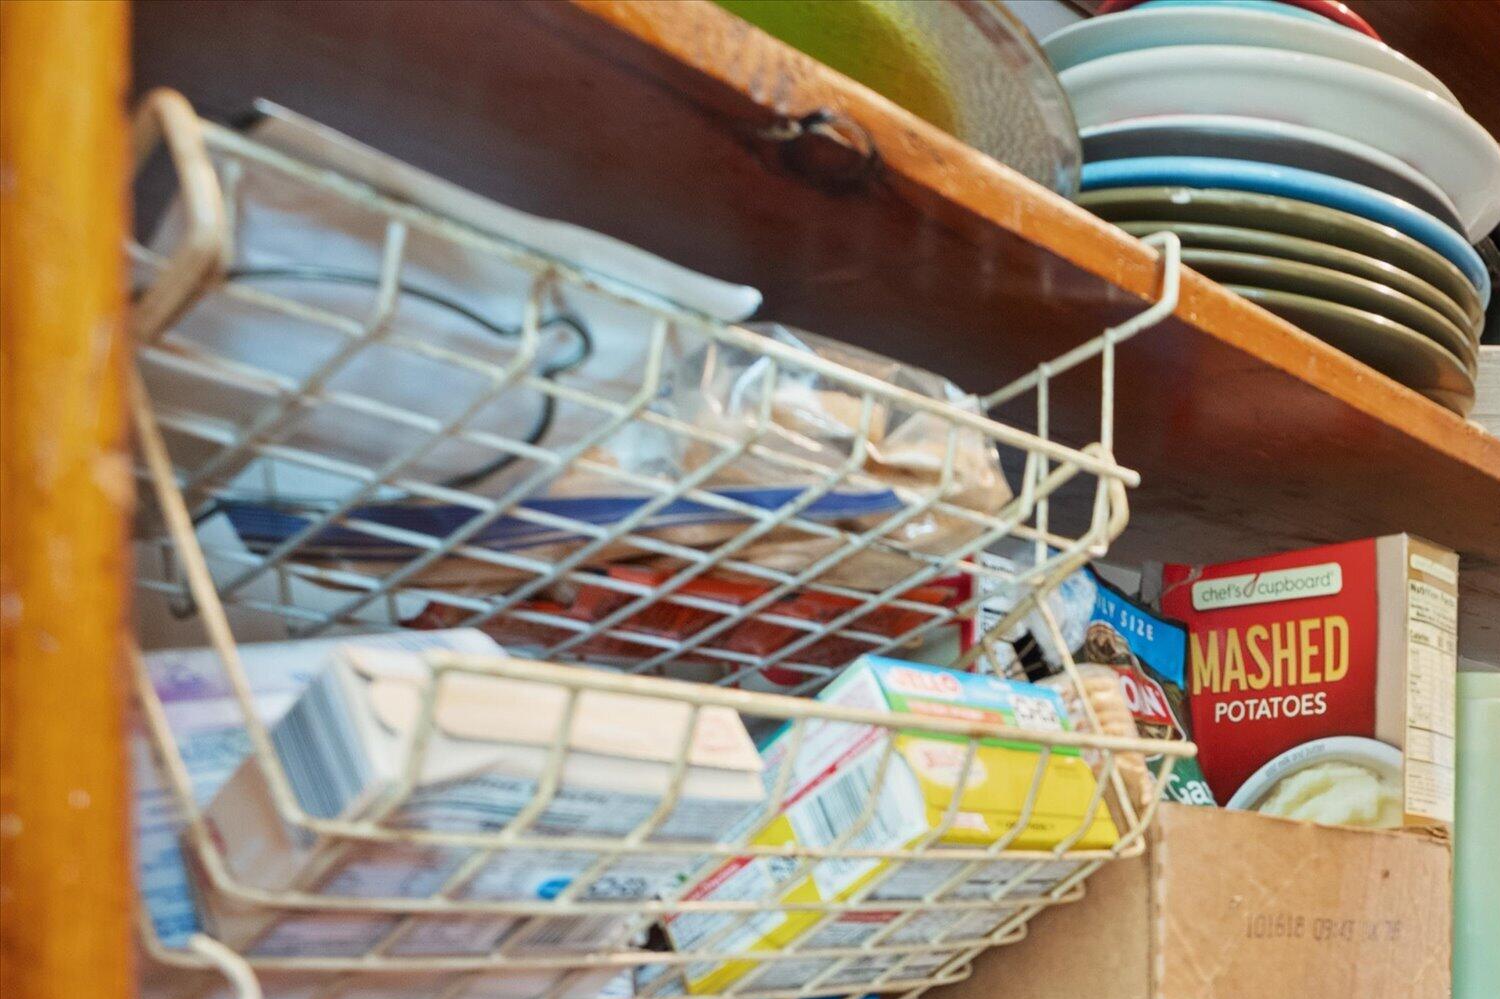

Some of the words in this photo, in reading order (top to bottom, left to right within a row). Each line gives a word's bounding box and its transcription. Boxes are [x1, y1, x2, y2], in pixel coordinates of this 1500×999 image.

[1201, 584, 1242, 603] chef's
[1257, 571, 1332, 598] cupboard
[1119, 609, 1155, 642] SIZE
[1190, 614, 1350, 694] MASHED
[1214, 690, 1328, 724] POTATOES
